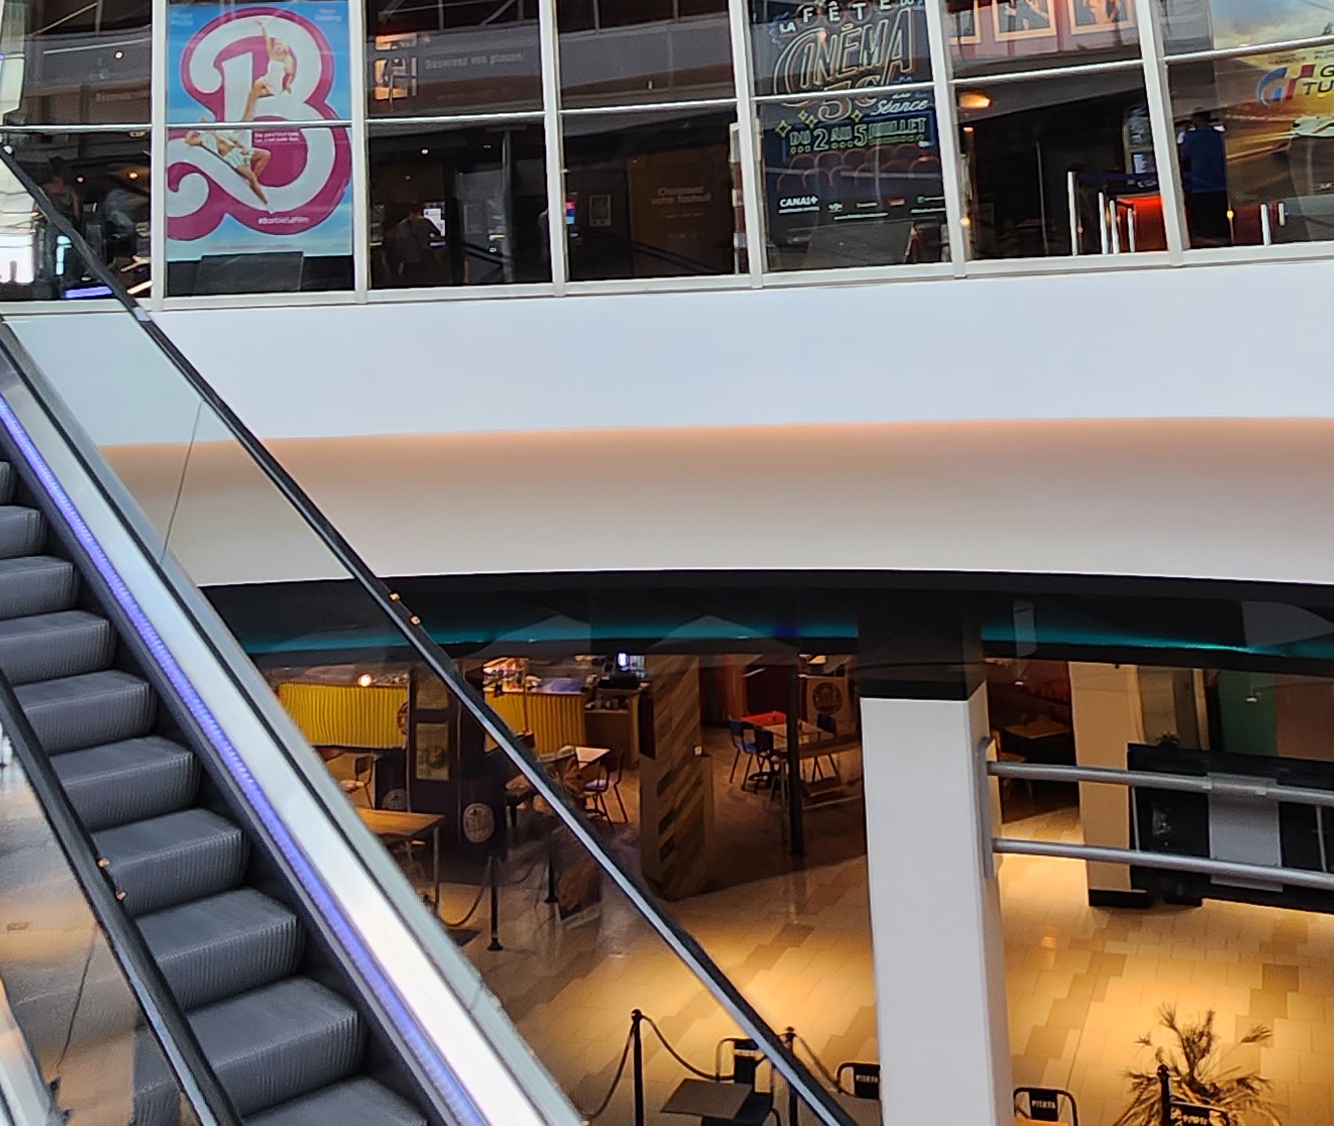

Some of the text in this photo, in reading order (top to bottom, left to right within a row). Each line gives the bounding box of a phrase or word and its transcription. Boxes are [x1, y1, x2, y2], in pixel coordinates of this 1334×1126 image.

[779, 22, 796, 33] LA
[870, 99, 929, 116] Séance
[789, 117, 927, 151] DU 2 AU 5 JUILLET
